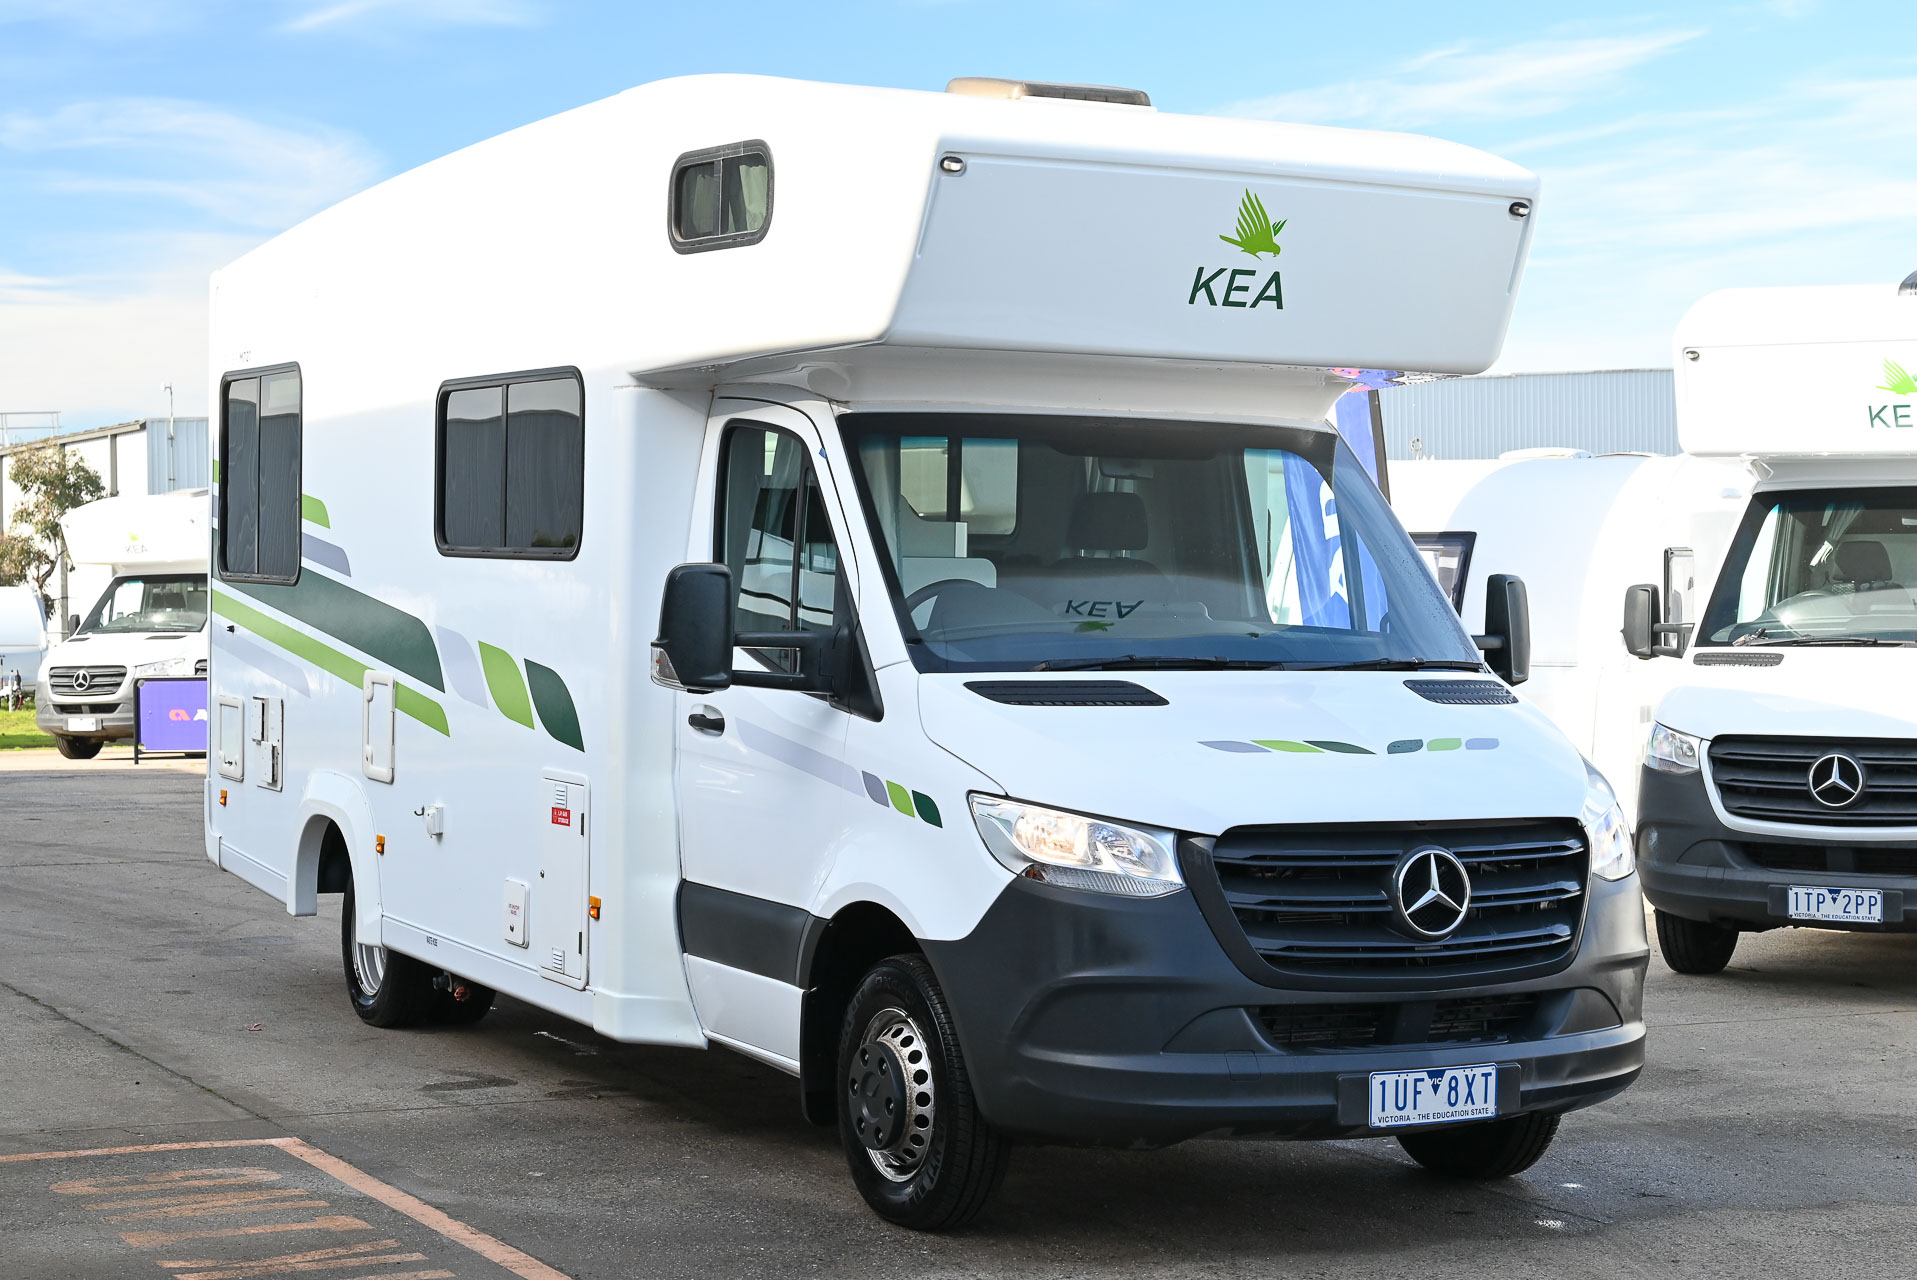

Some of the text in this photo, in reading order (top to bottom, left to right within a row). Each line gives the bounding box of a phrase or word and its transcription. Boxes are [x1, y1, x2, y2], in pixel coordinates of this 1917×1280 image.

[1188, 266, 1284, 310] KEA
[1868, 404, 1914, 429] KE
[1794, 891, 1877, 914] 1TP 2PP
[1379, 1072, 1492, 1112] 1UF 8XT
[1378, 1114, 1411, 1123] VICTORIA
[1417, 1112, 1431, 1120] THE
[1432, 1109, 1469, 1119] EDUCATION
[1470, 1107, 1489, 1116] STATE
